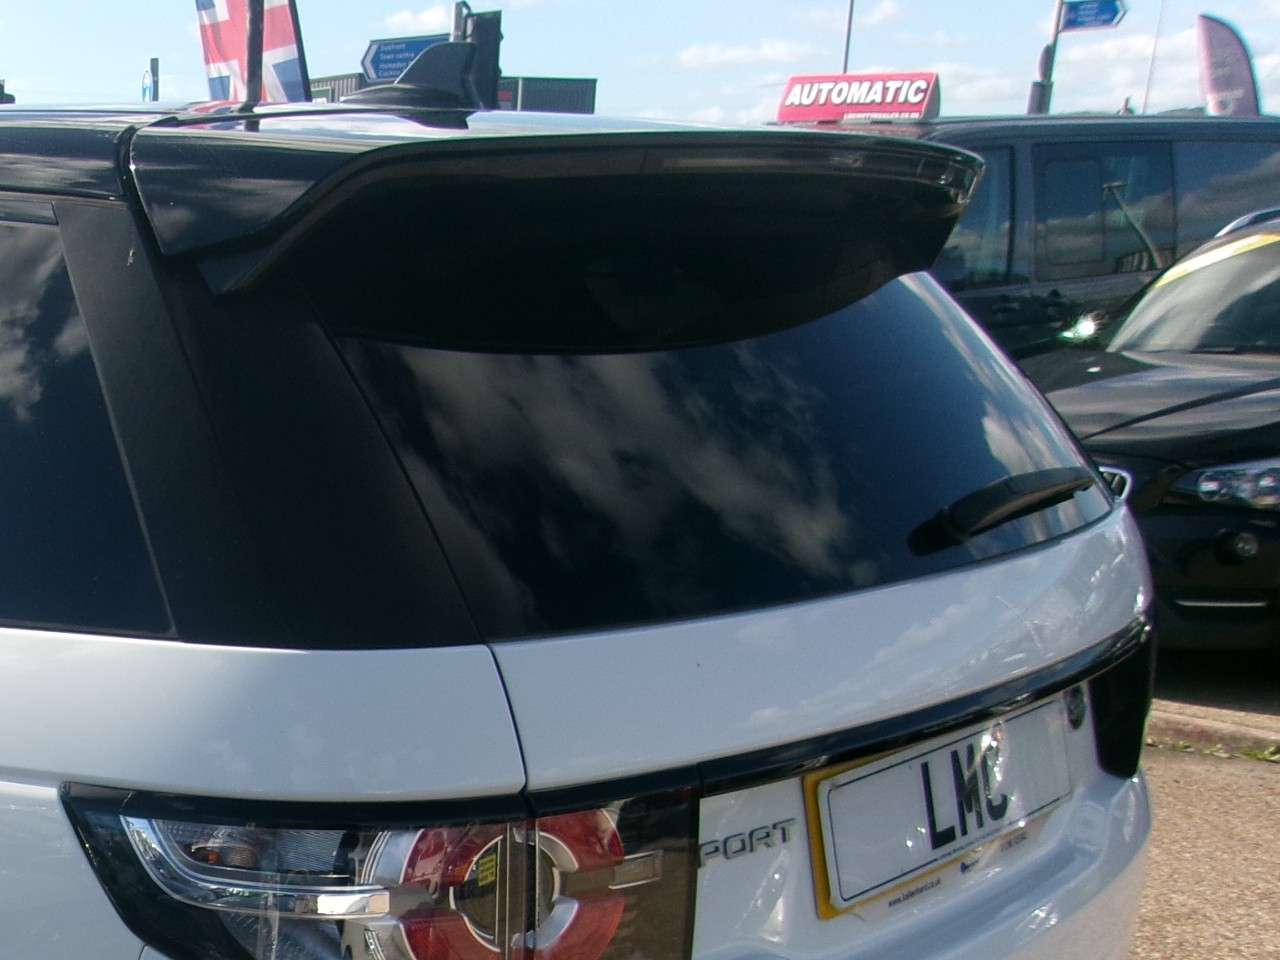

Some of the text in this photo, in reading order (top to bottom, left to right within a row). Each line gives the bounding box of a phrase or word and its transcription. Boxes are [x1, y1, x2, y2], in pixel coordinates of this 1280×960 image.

[784, 79, 929, 106] AUTOMATIC
[921, 741, 1009, 850] LMC
[698, 817, 797, 868] PORT
